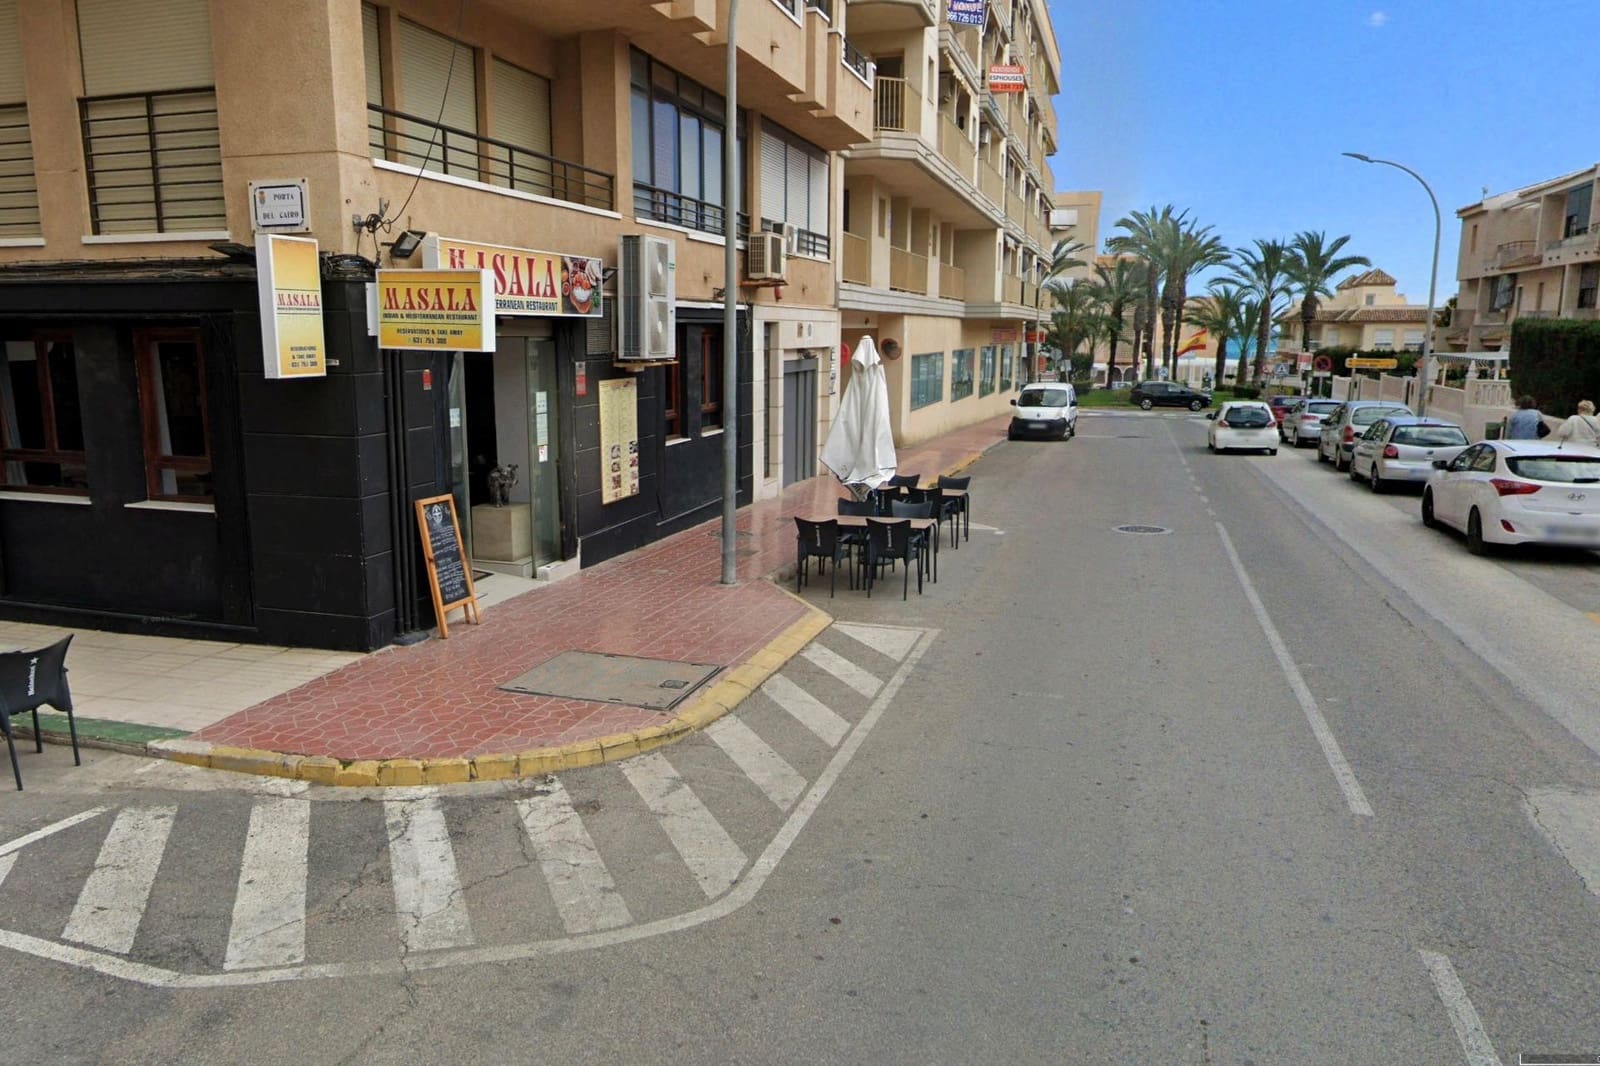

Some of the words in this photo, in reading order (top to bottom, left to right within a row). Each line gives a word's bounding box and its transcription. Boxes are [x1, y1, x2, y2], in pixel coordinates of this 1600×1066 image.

[970, 14, 983, 24] 013
[277, 293, 320, 307] MASALA
[383, 287, 477, 311] MASALA
[495, 300, 525, 310] ERRANEAN
[526, 300, 558, 312] RESTAURANT
